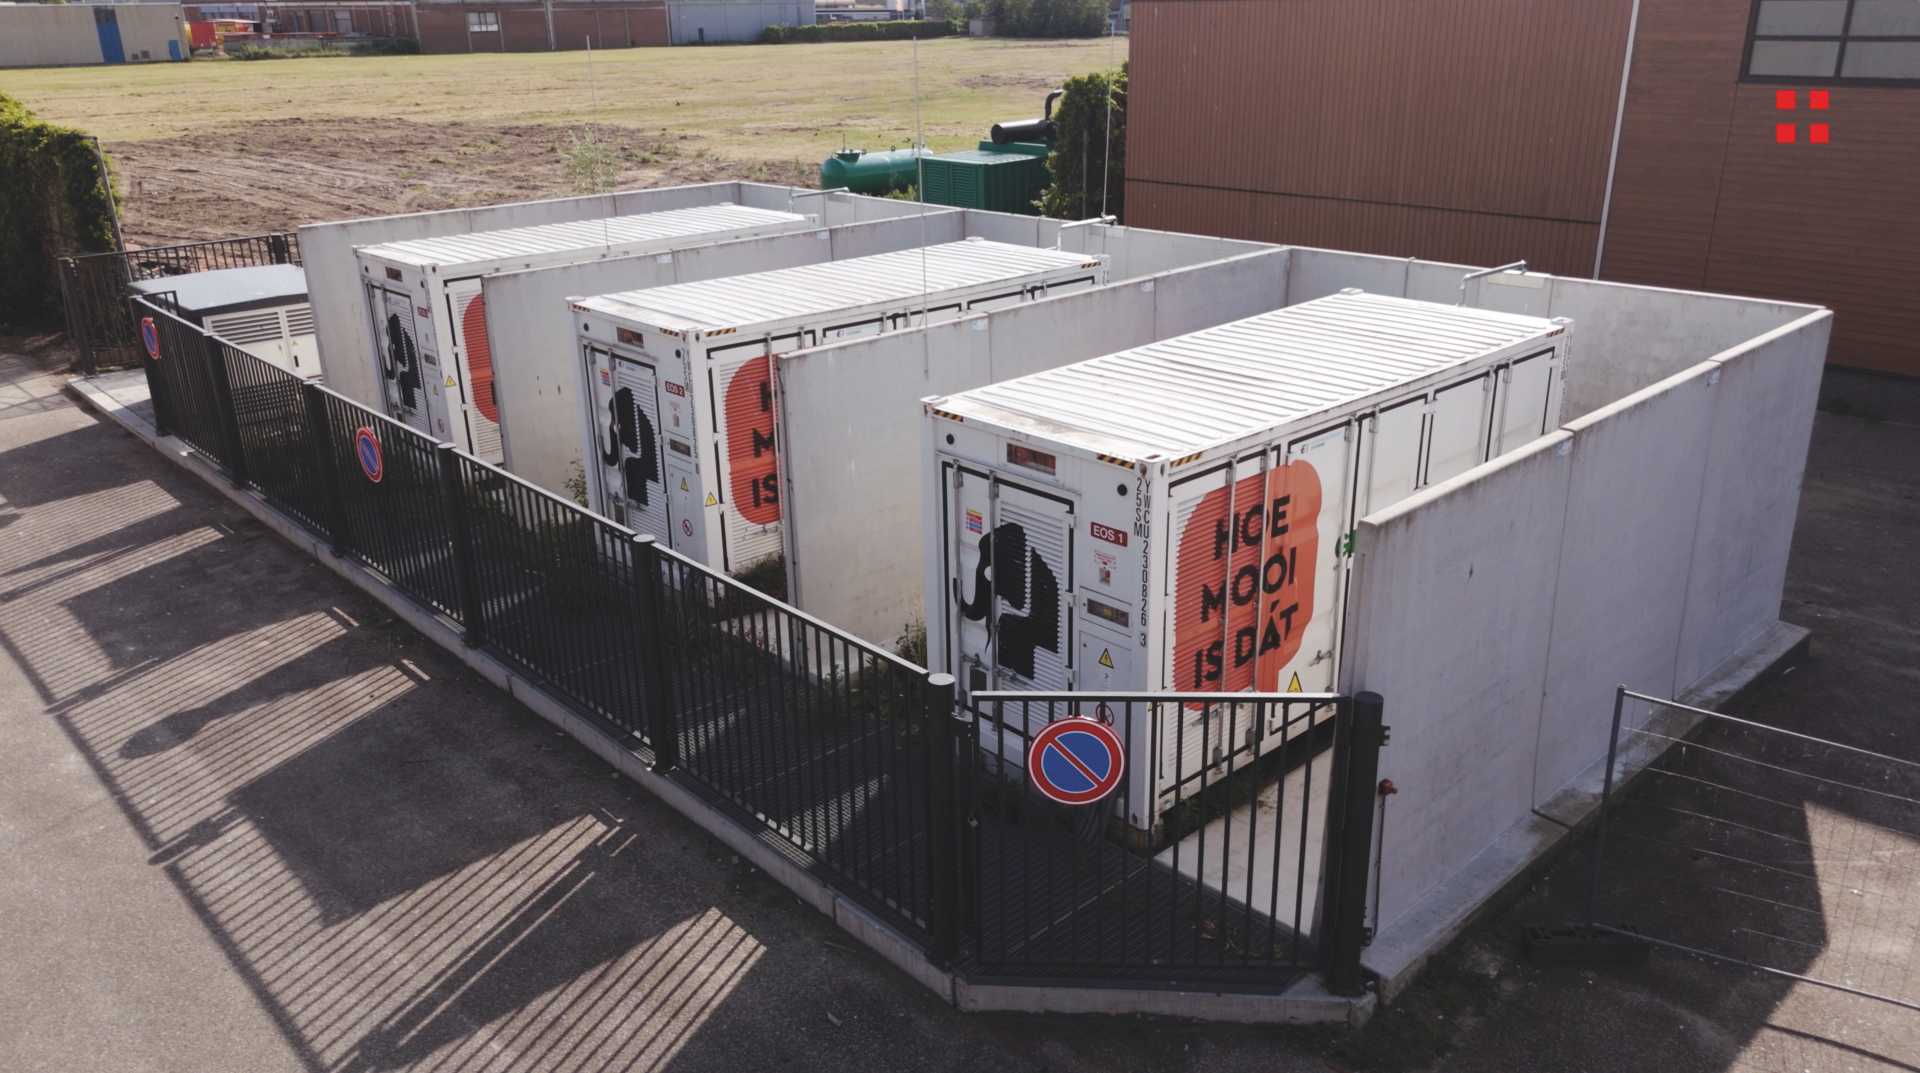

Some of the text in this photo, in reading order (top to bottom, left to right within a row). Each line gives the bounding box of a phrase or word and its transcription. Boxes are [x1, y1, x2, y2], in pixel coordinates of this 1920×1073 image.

[1093, 525, 1123, 544] EOS 1
[1214, 495, 1290, 561] HOE
[1194, 599, 1298, 688] IS DÁT
